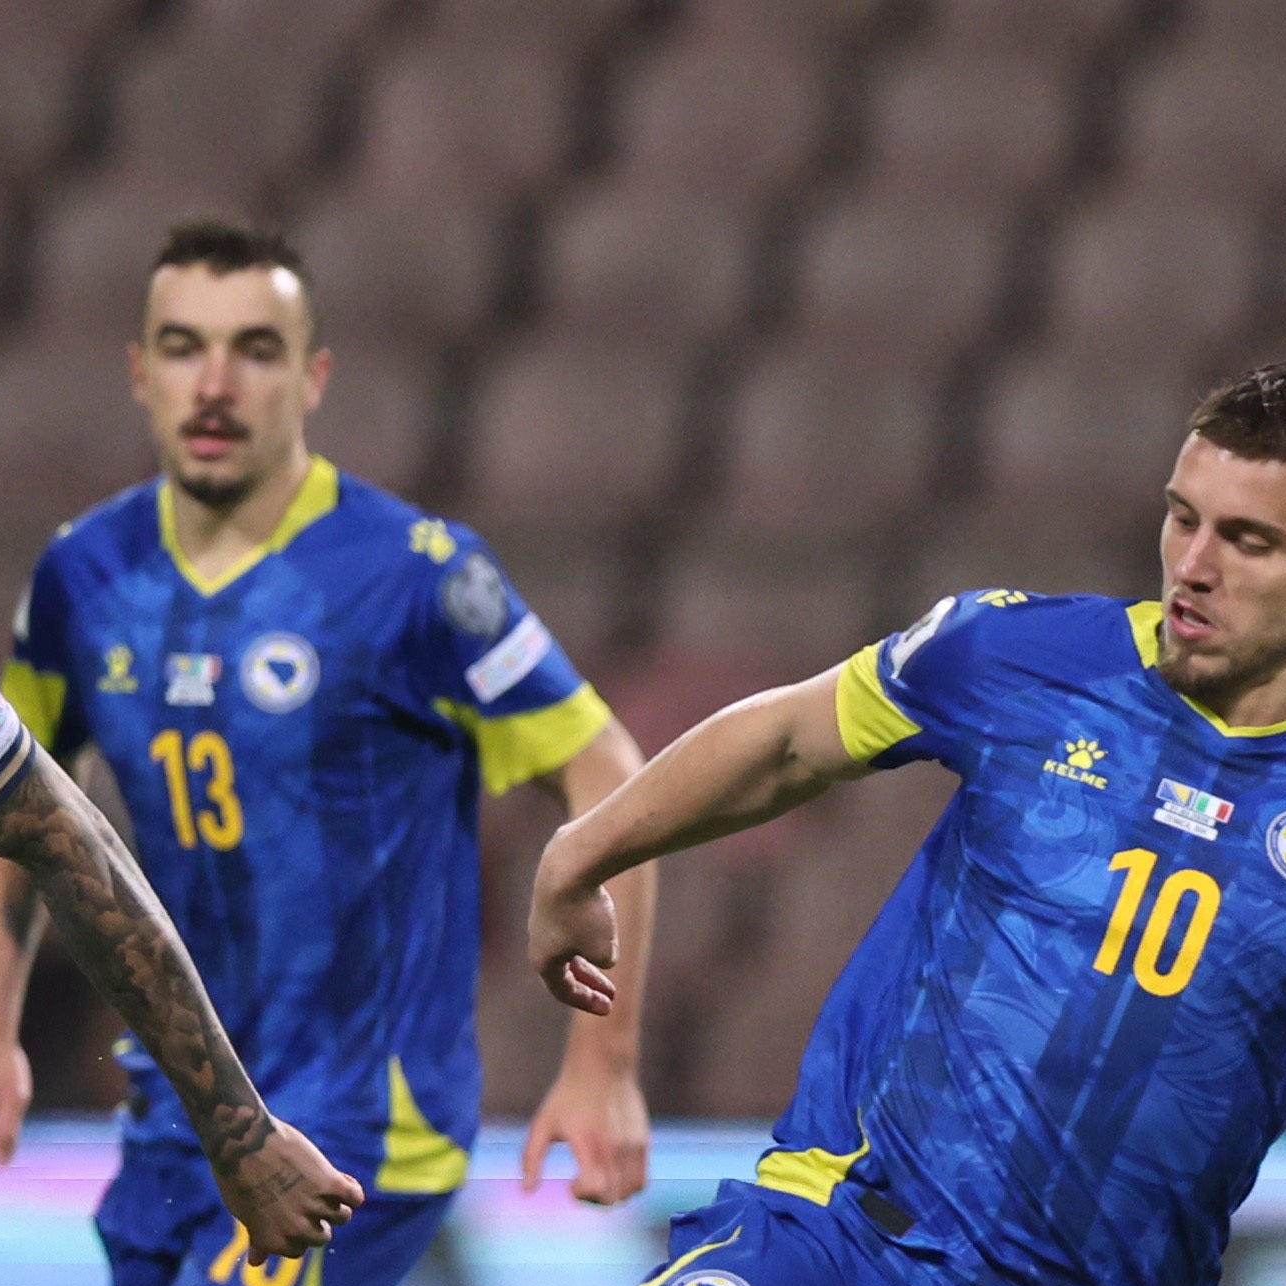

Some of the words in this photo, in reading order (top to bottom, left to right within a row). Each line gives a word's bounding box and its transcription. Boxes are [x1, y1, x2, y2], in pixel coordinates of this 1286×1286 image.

[149, 728, 244, 852] 13
[1042, 759, 1109, 790] KELME
[1092, 847, 1222, 997] 10
